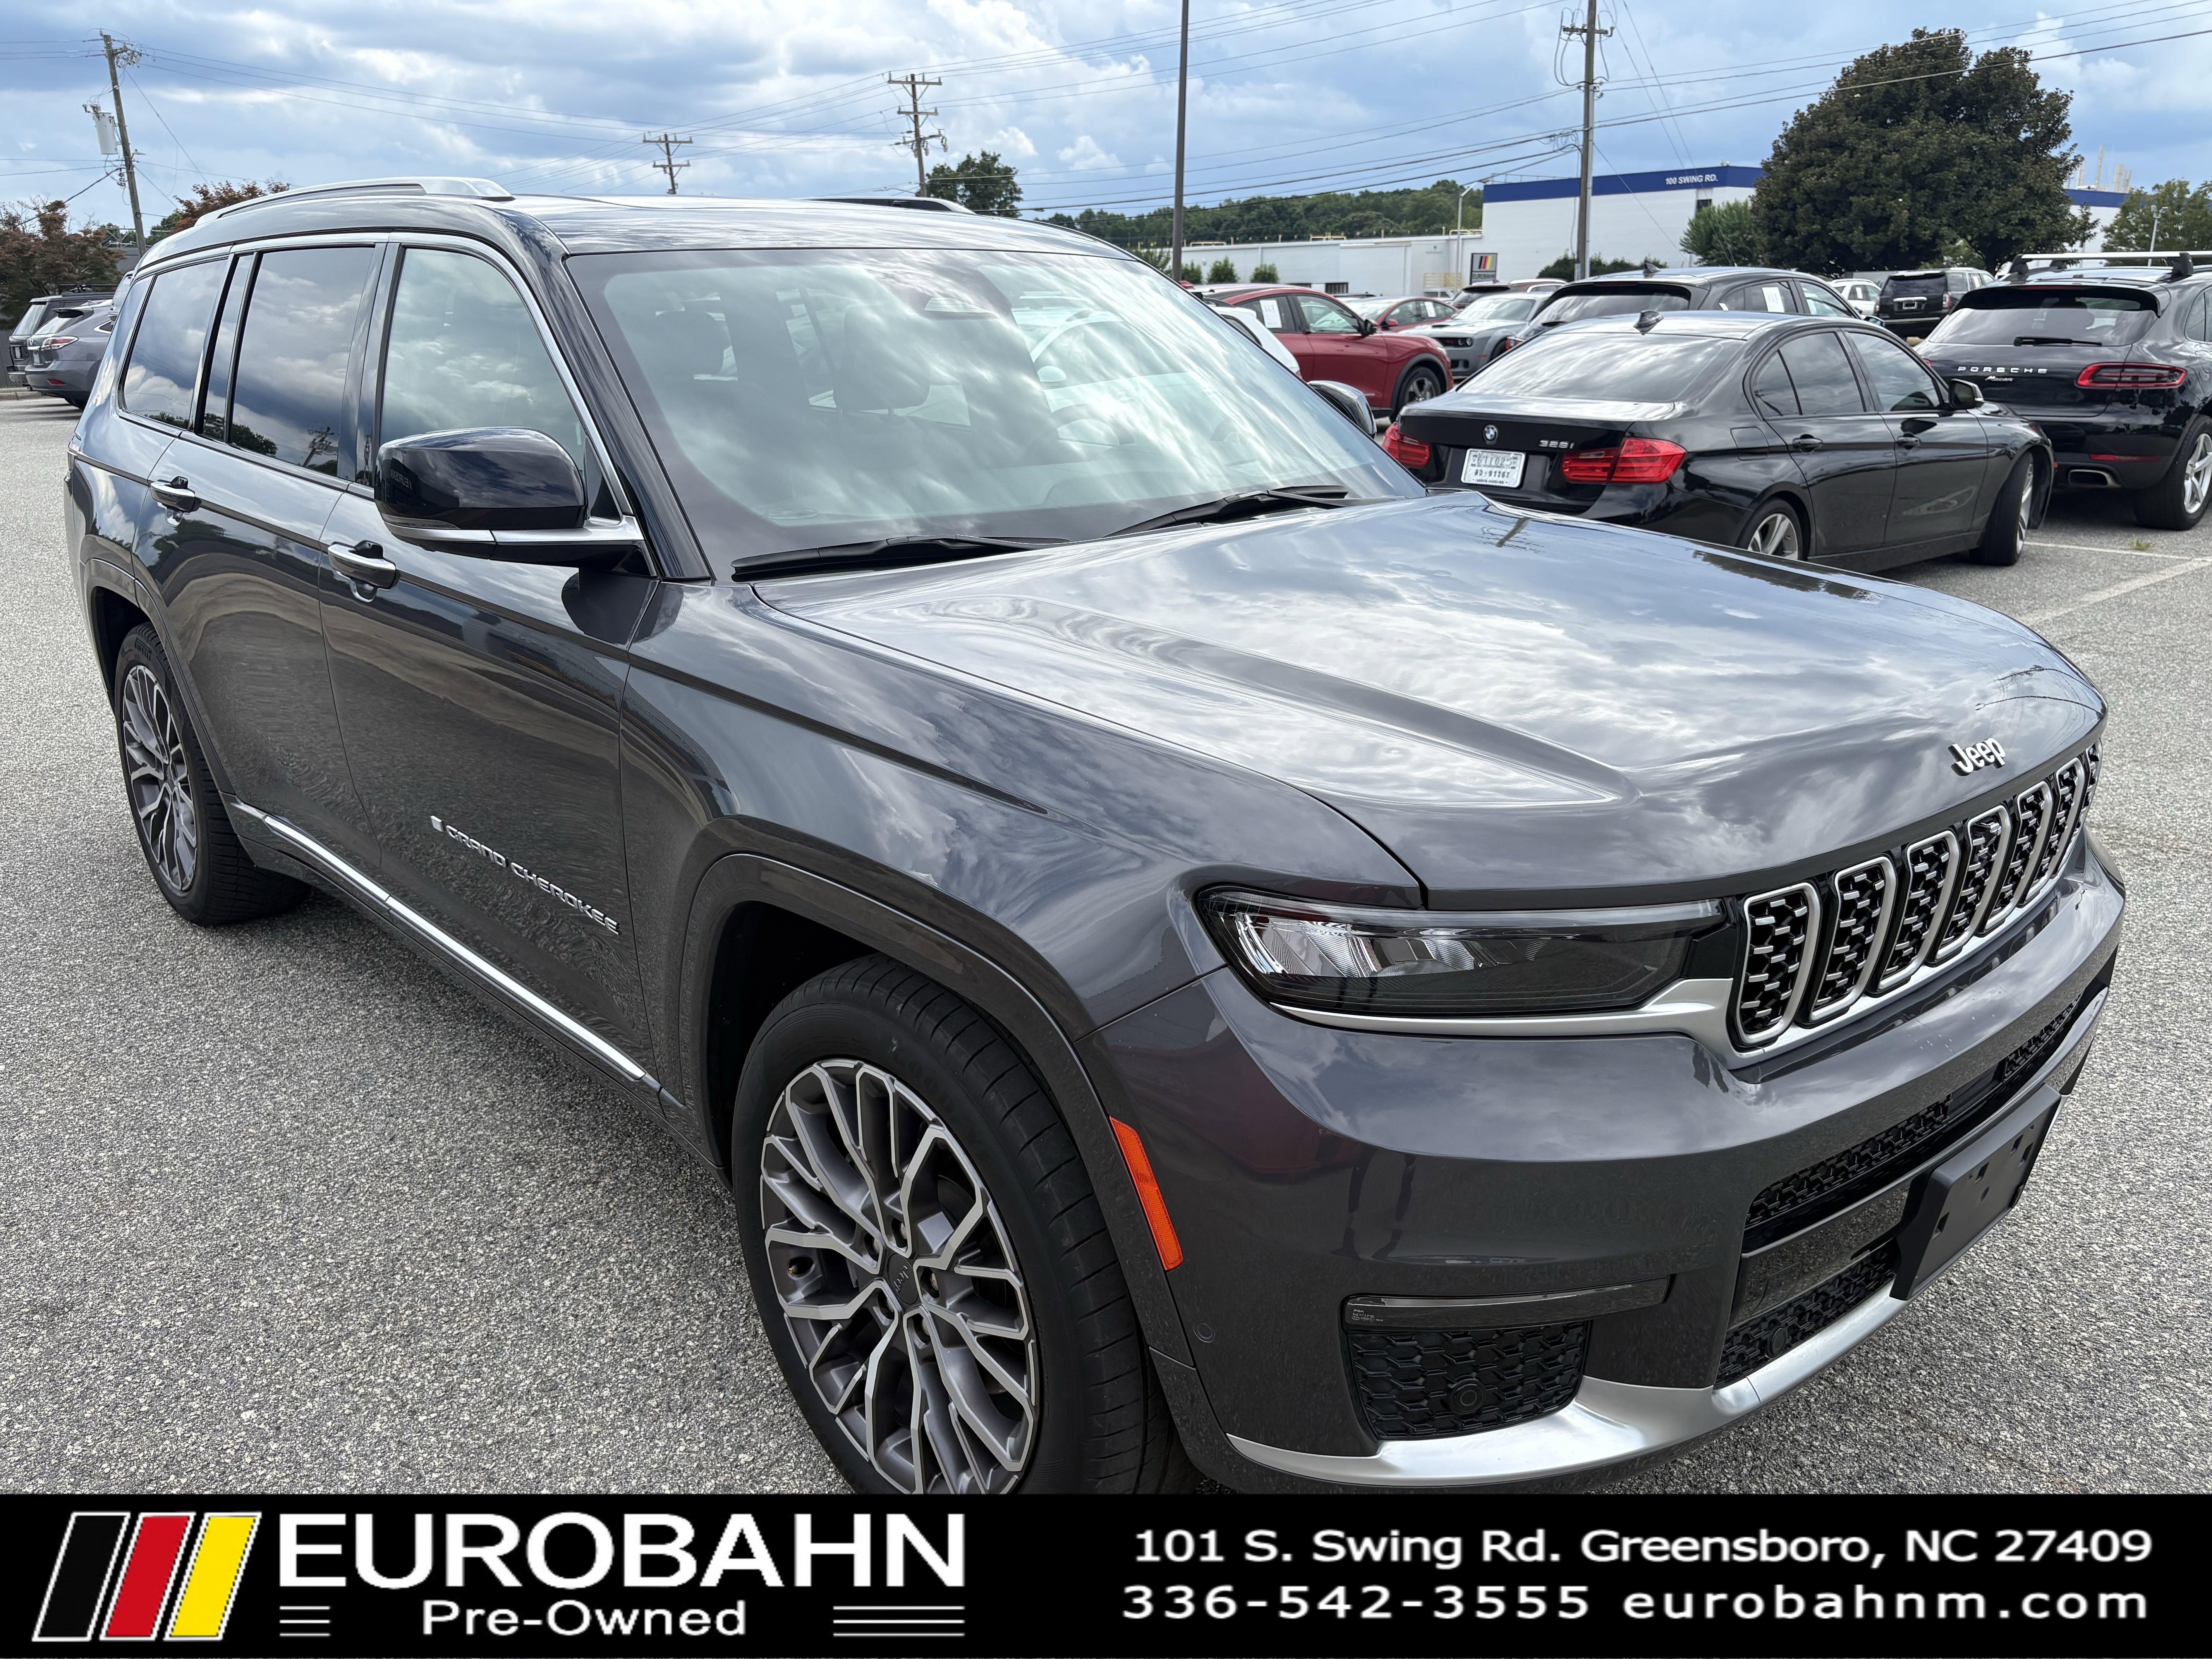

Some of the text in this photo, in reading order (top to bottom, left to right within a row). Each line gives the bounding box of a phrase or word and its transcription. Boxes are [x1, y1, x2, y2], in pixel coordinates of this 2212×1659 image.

[1678, 175, 1704, 184] SWING
[1948, 738, 2006, 776] Jeep
[446, 825, 622, 935] GRAND CHEROKEE
